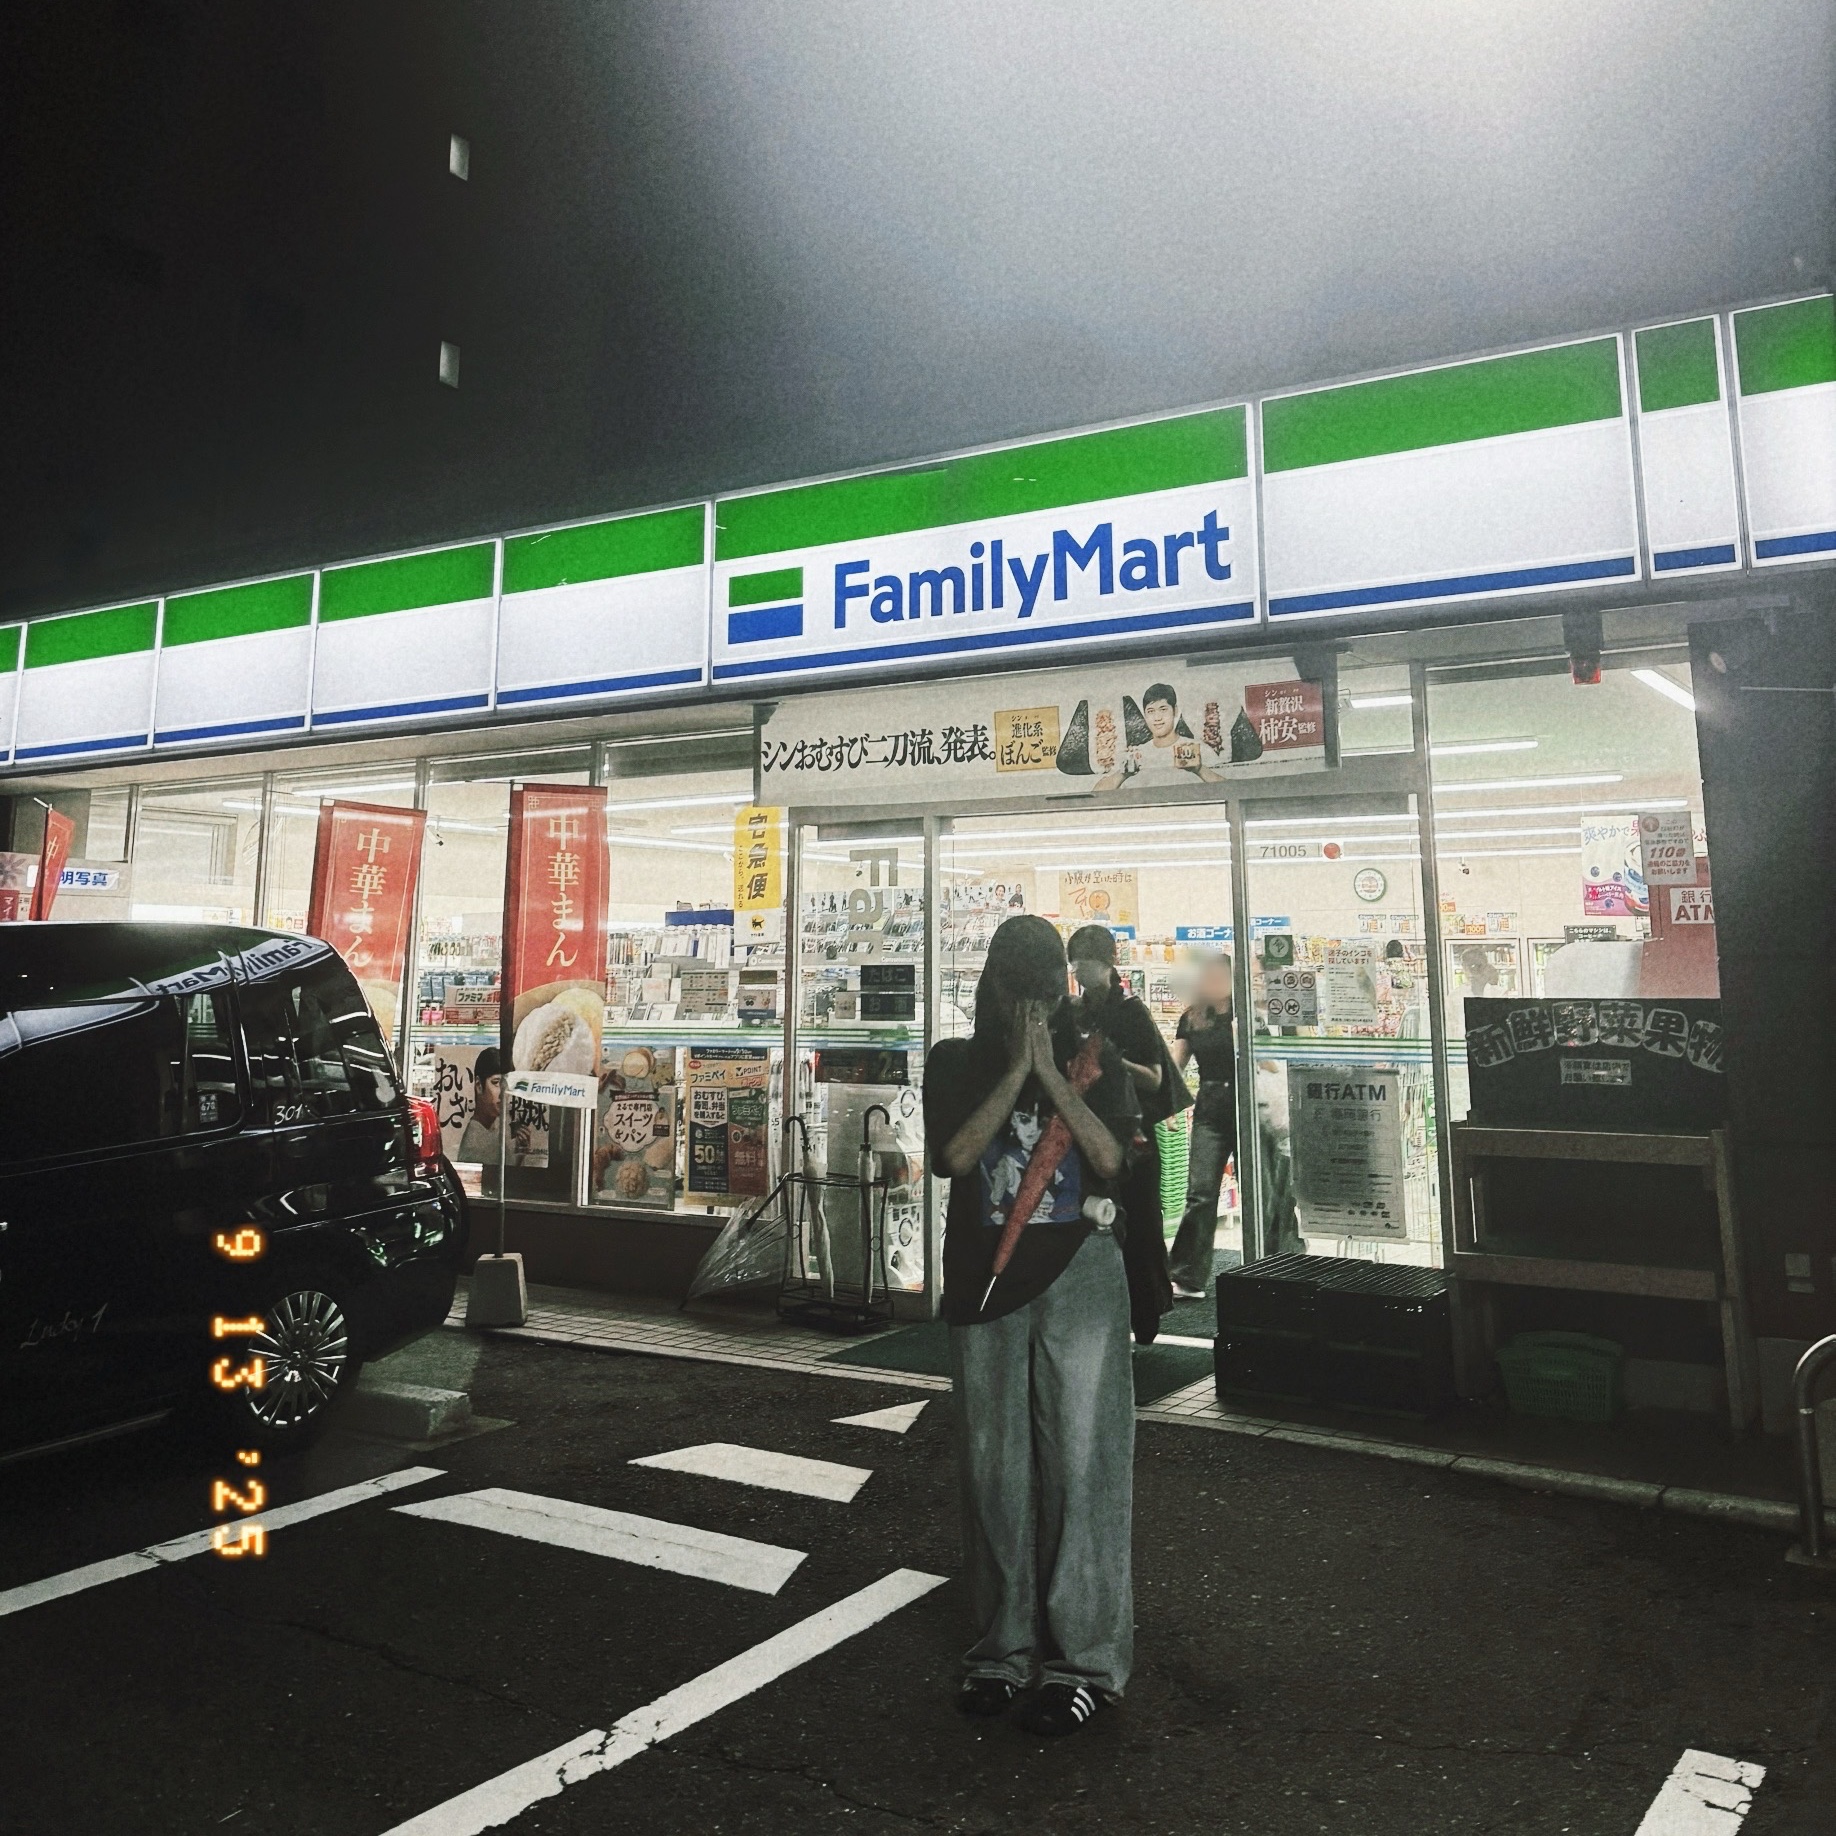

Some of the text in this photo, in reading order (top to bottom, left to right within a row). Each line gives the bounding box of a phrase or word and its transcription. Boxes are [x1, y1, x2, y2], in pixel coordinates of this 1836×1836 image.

[834, 509, 1232, 629] FamilyMart
[1011, 720, 1043, 739] 進化系
[1259, 716, 1298, 744] 柿安
[761, 723, 996, 772] シンおむすび二刀流、発表。
[1001, 739, 1044, 766] ぼんご
[747, 813, 769, 900] 宅急便
[1259, 845, 1307, 859] 71005
[343, 827, 392, 967] 中華まん
[546, 814, 580, 967] 中華まん
[690, 1069, 726, 1084] ファミペイ
[531, 1082, 586, 1098] FamilyMart
[274, 1103, 304, 1126] 301
[613, 1112, 653, 1128] スイーツ
[694, 1144, 715, 1164] 50
